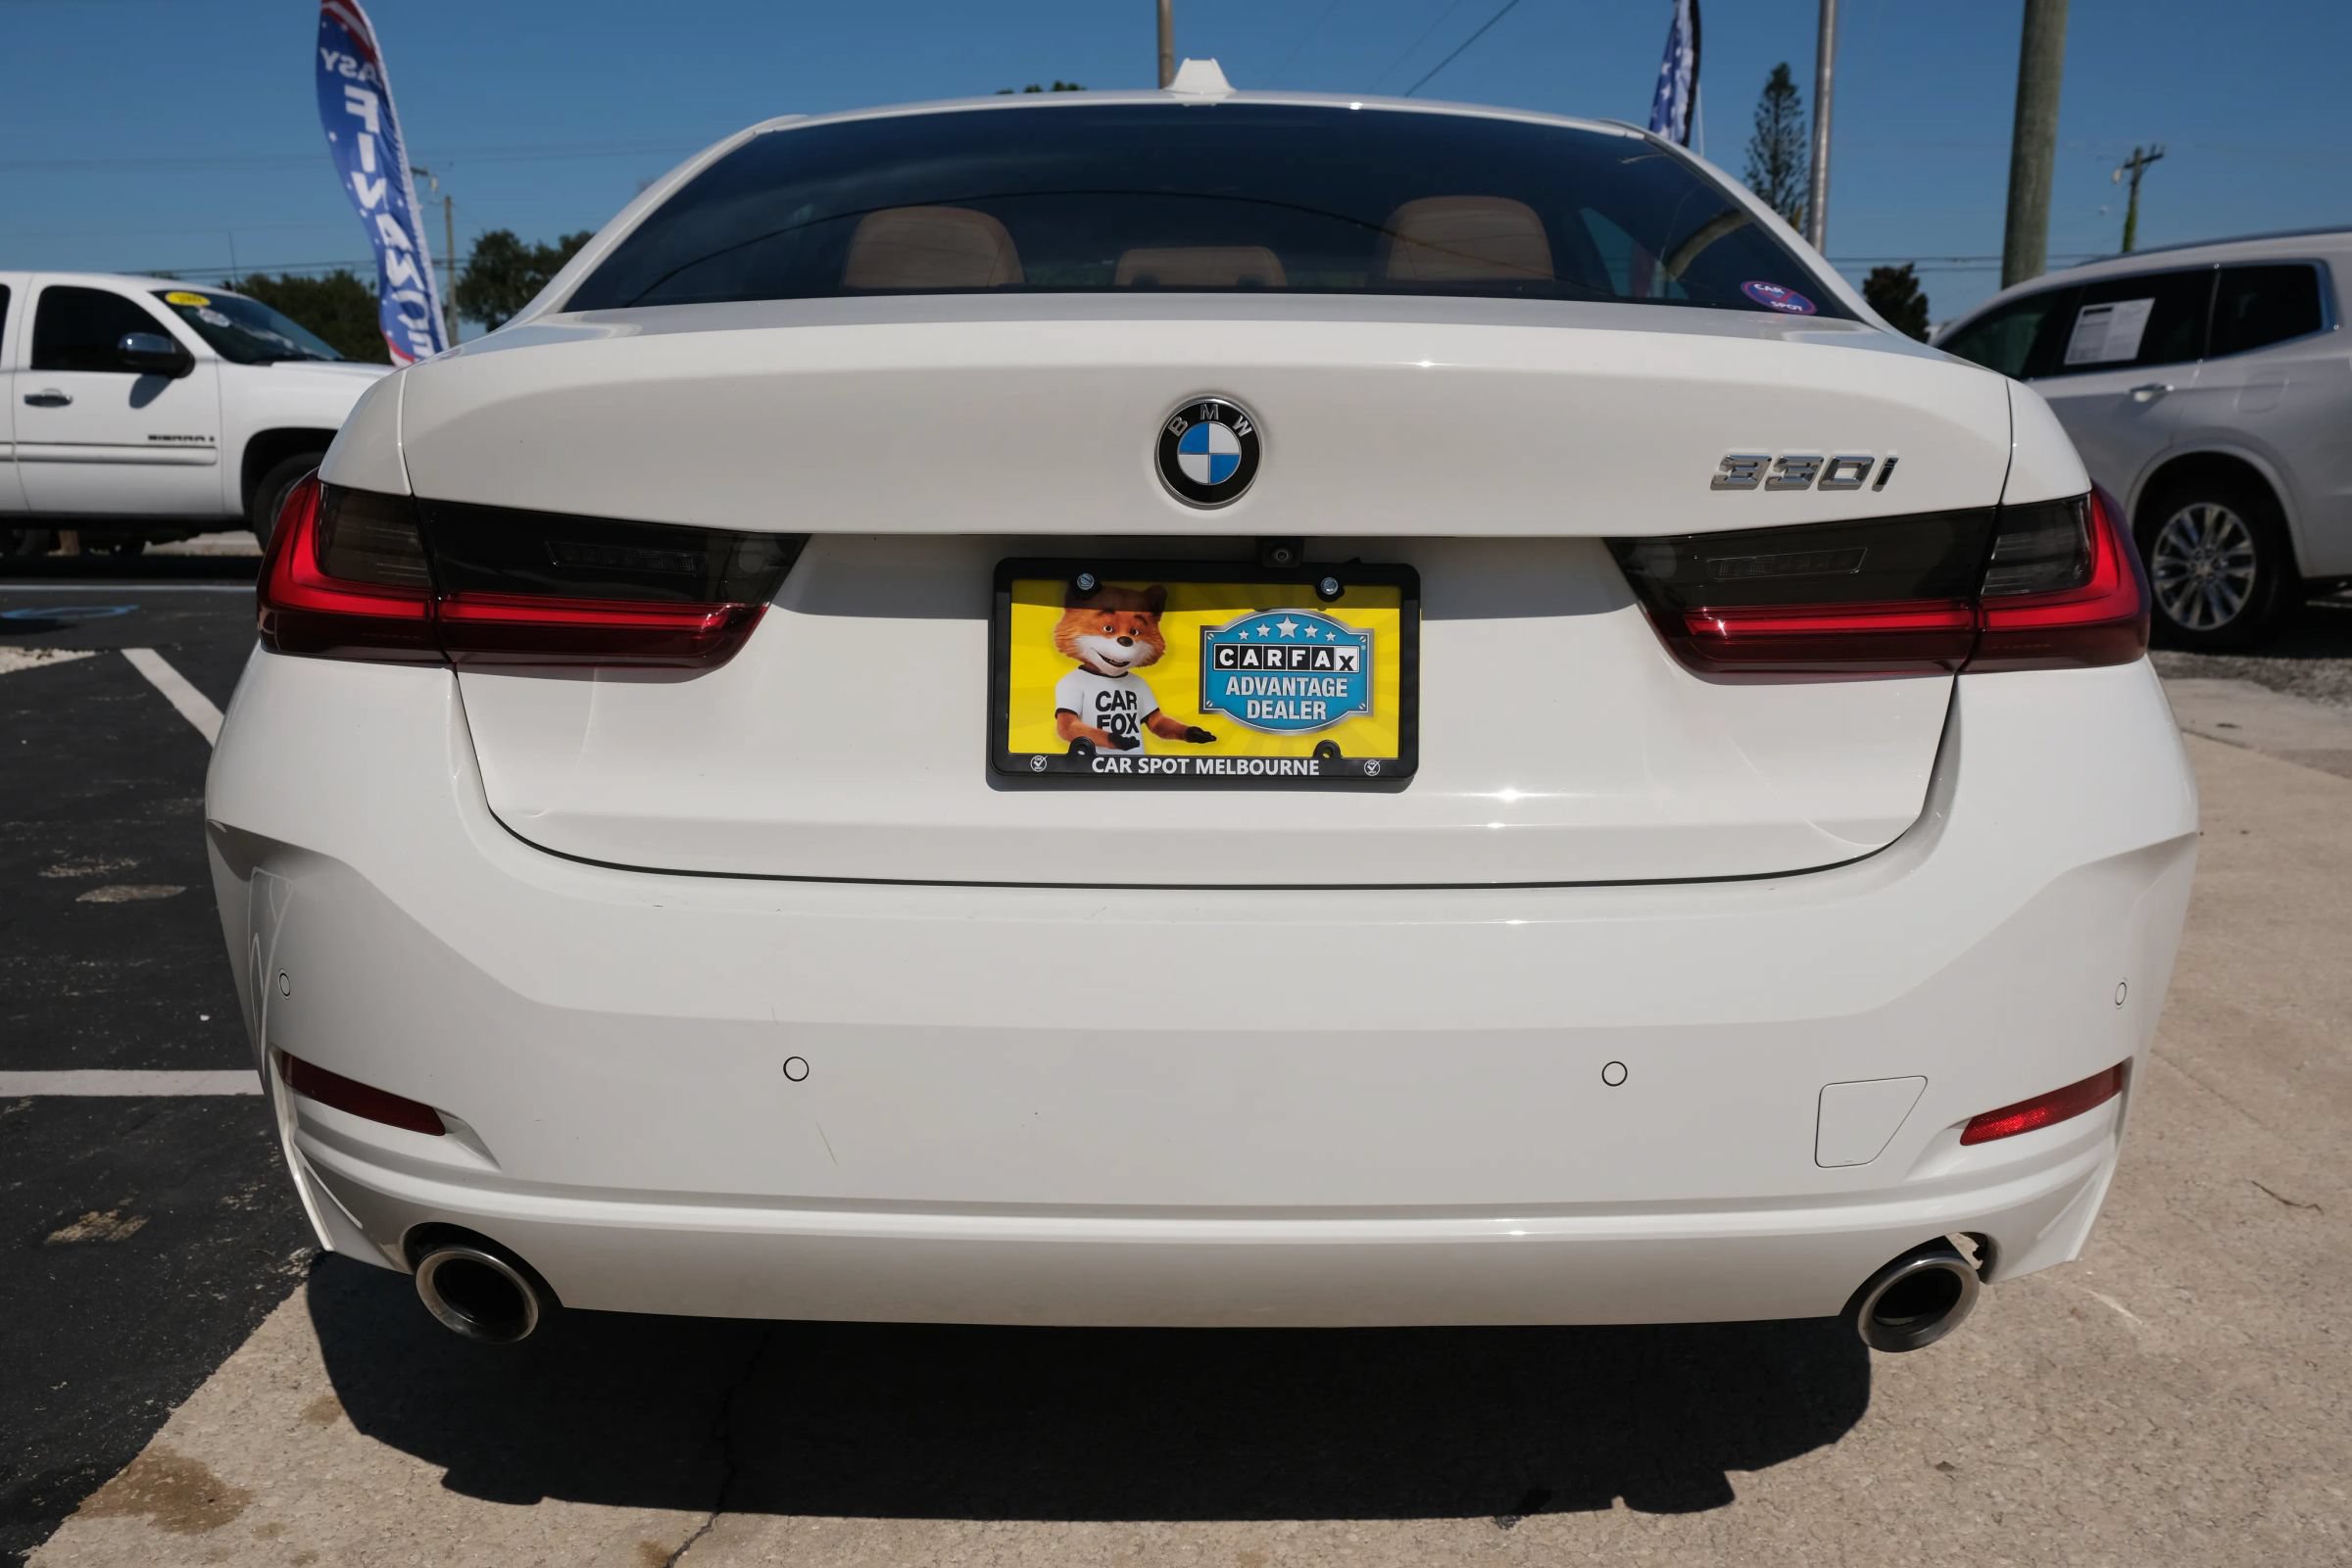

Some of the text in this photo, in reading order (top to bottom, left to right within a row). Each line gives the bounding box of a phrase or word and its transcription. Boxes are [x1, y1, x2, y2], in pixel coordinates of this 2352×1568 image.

[1167, 403, 1253, 437] BMW
[1710, 455, 1899, 492] 330i
[1219, 647, 1354, 671] CARFAX
[1225, 676, 1348, 698] ADVANTAGE
[1095, 689, 1138, 712] CAR
[1247, 700, 1327, 720] DEALER
[1097, 712, 1140, 735] FOX
[1092, 757, 1320, 776] CAR SPOT MELBOURNE
